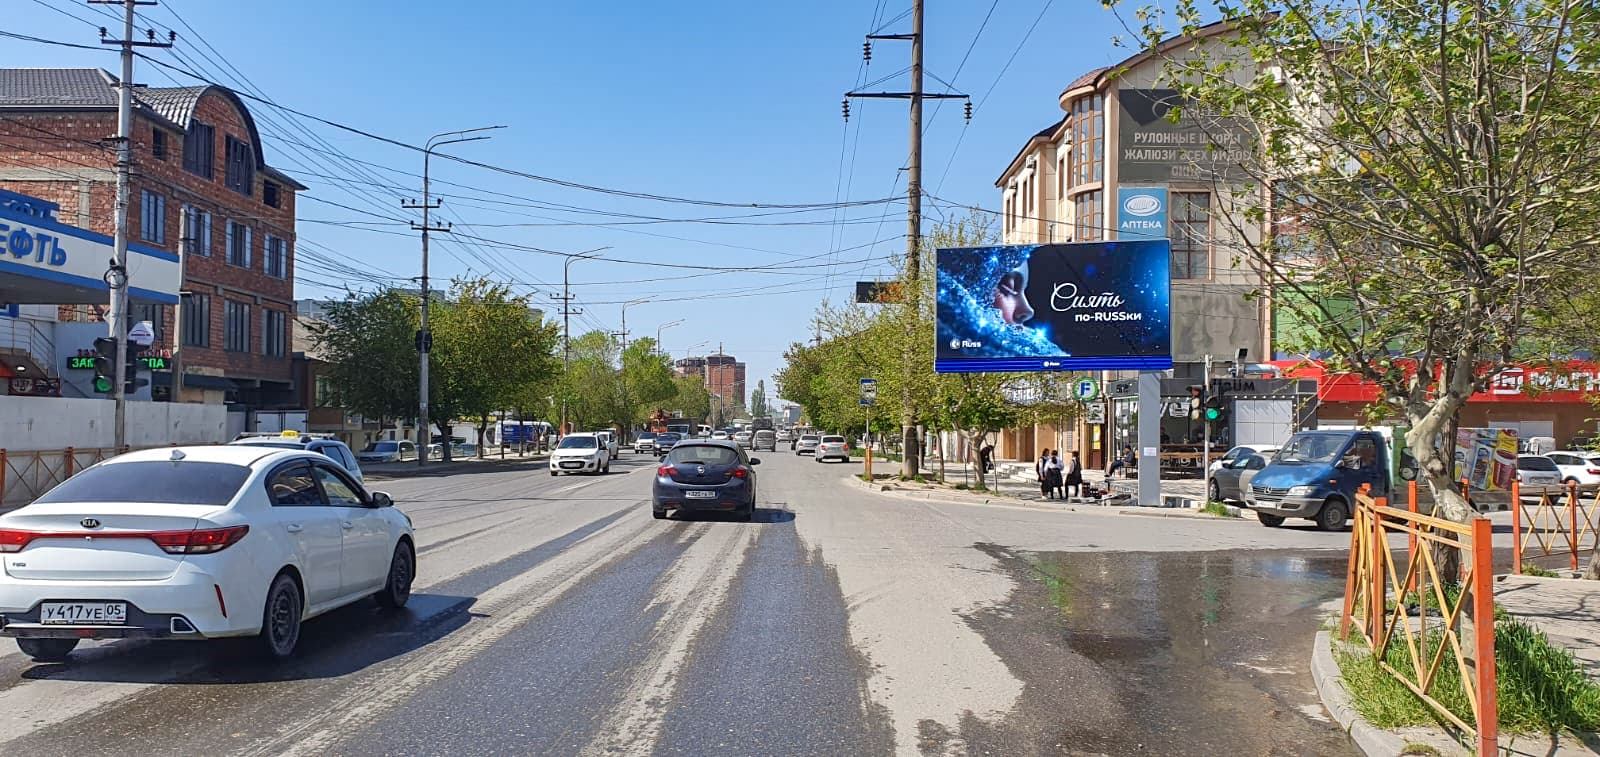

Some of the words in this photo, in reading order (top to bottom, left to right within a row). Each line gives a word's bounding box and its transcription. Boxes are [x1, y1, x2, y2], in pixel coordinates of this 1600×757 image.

[1134, 132, 1196, 144] РУЛОННЫЕ
[1124, 149, 1176, 160] ЖАЛЮЗИ
[1121, 220, 1162, 229] АПТЕКА
[1050, 282, 1125, 312] Сиять
[1075, 312, 1142, 322] по-RUSSки
[1080, 382, 1091, 396] F
[82, 519, 97, 527] KIA
[106, 604, 121, 616] 05
